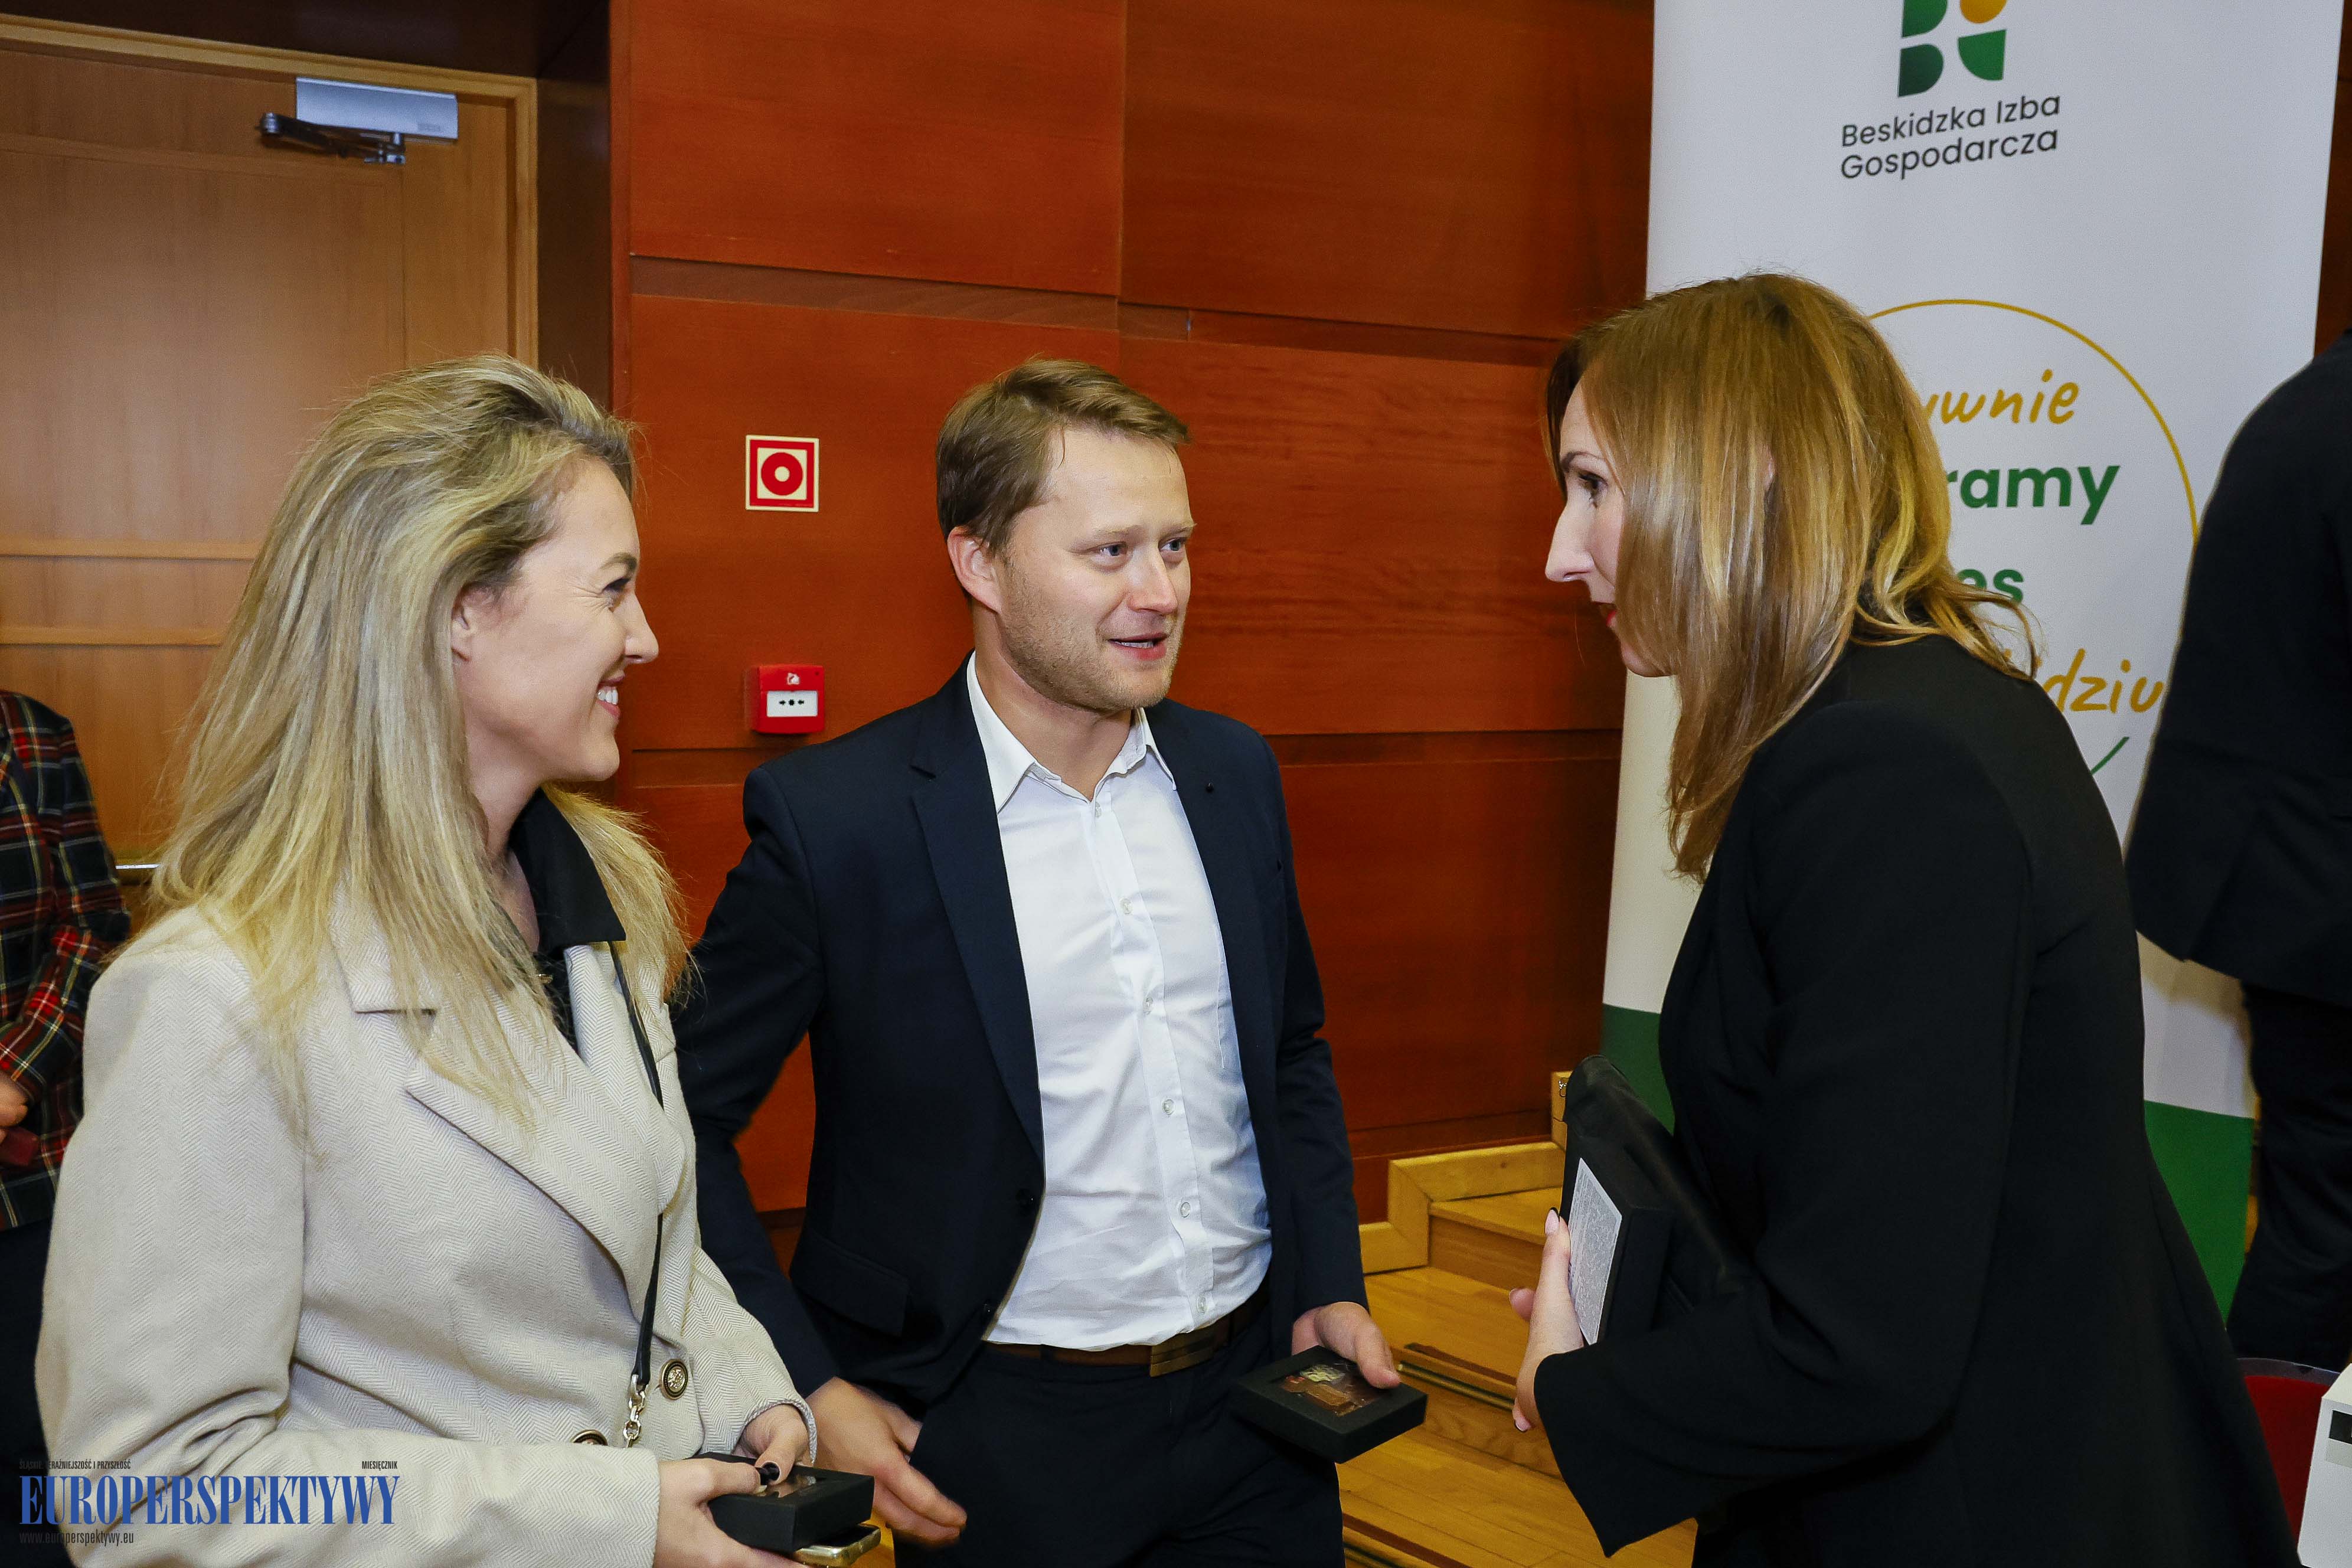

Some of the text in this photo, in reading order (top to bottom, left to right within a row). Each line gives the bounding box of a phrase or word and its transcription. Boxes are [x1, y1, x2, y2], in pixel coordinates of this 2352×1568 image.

[1841, 95, 2060, 147] Beskidzka Izba
[1840, 129, 2059, 180] Gospodarcza
